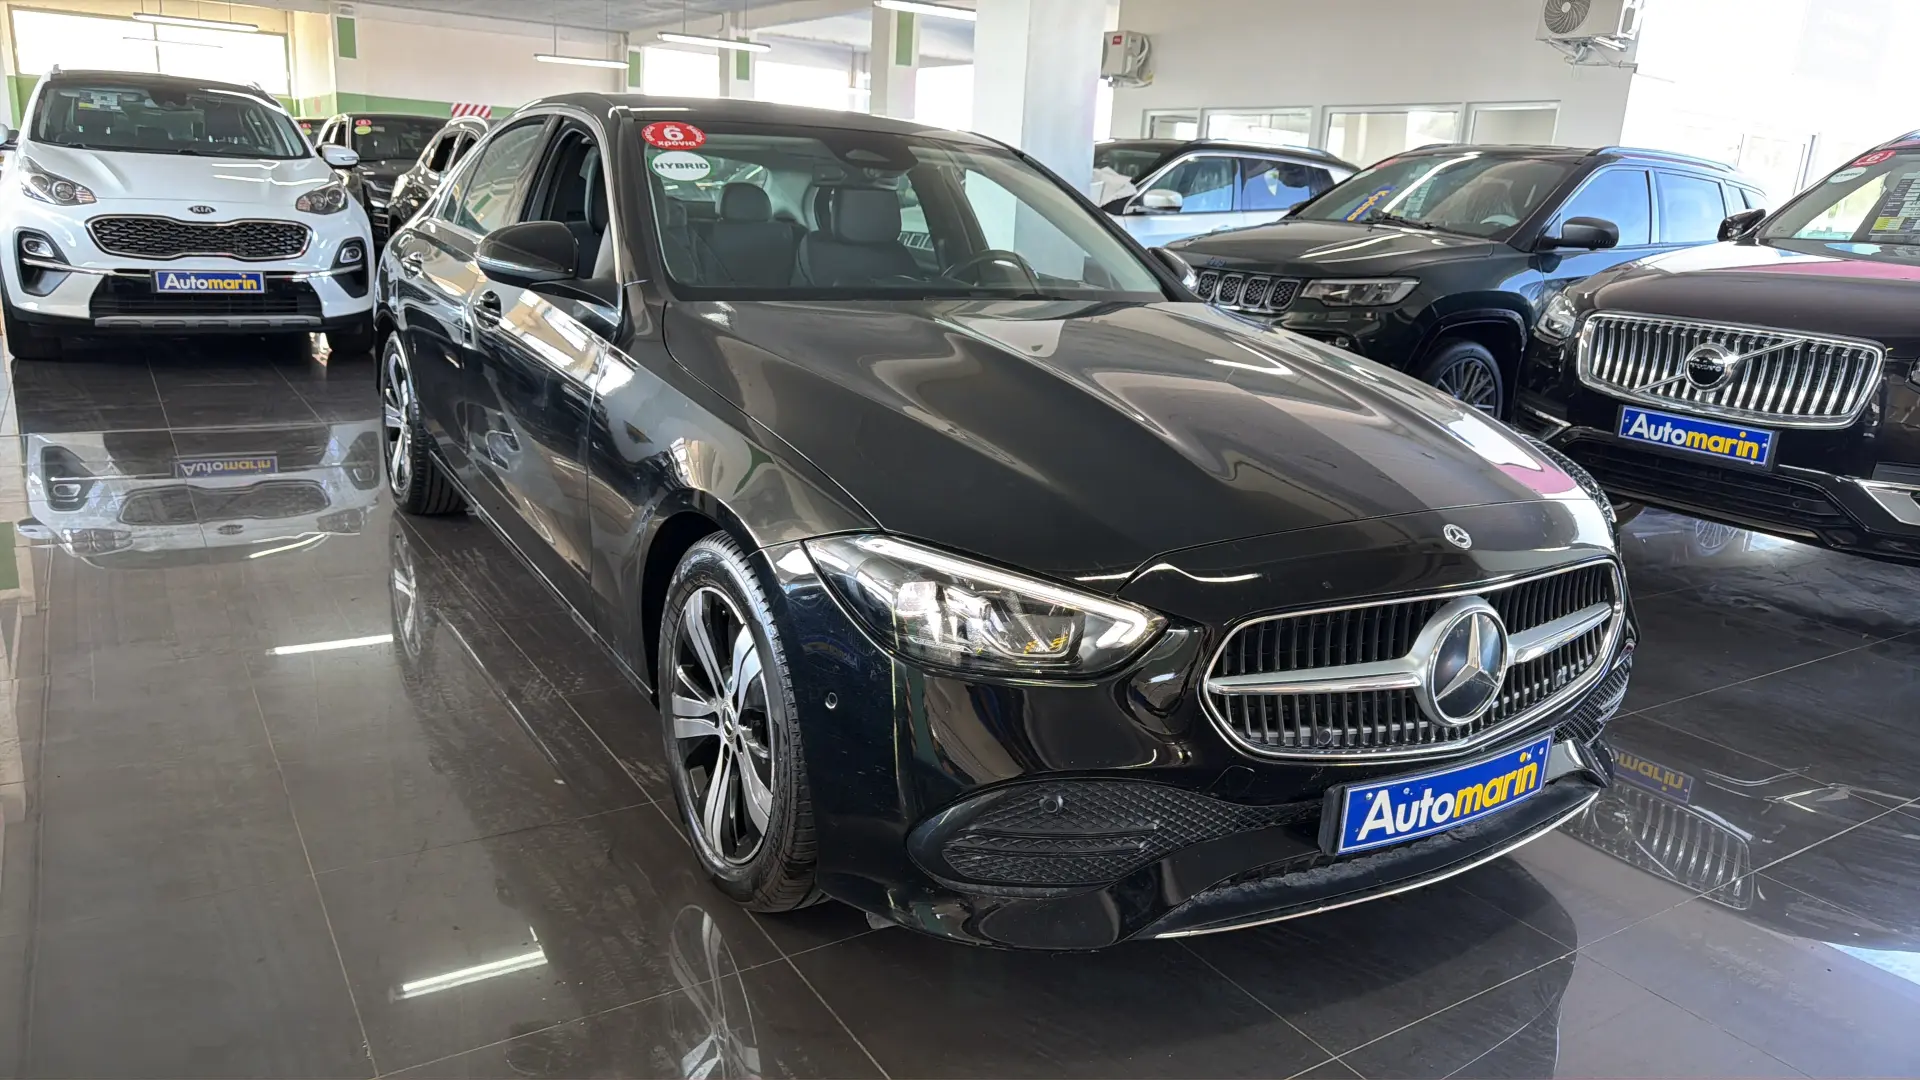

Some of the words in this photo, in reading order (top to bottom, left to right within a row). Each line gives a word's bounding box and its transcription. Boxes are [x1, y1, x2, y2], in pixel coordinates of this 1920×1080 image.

[663, 127, 685, 141] 6
[654, 162, 709, 170] HYBRID
[163, 273, 258, 290] Automarin
[1628, 413, 1759, 460] Automarin
[1356, 751, 1538, 842] Automarin
